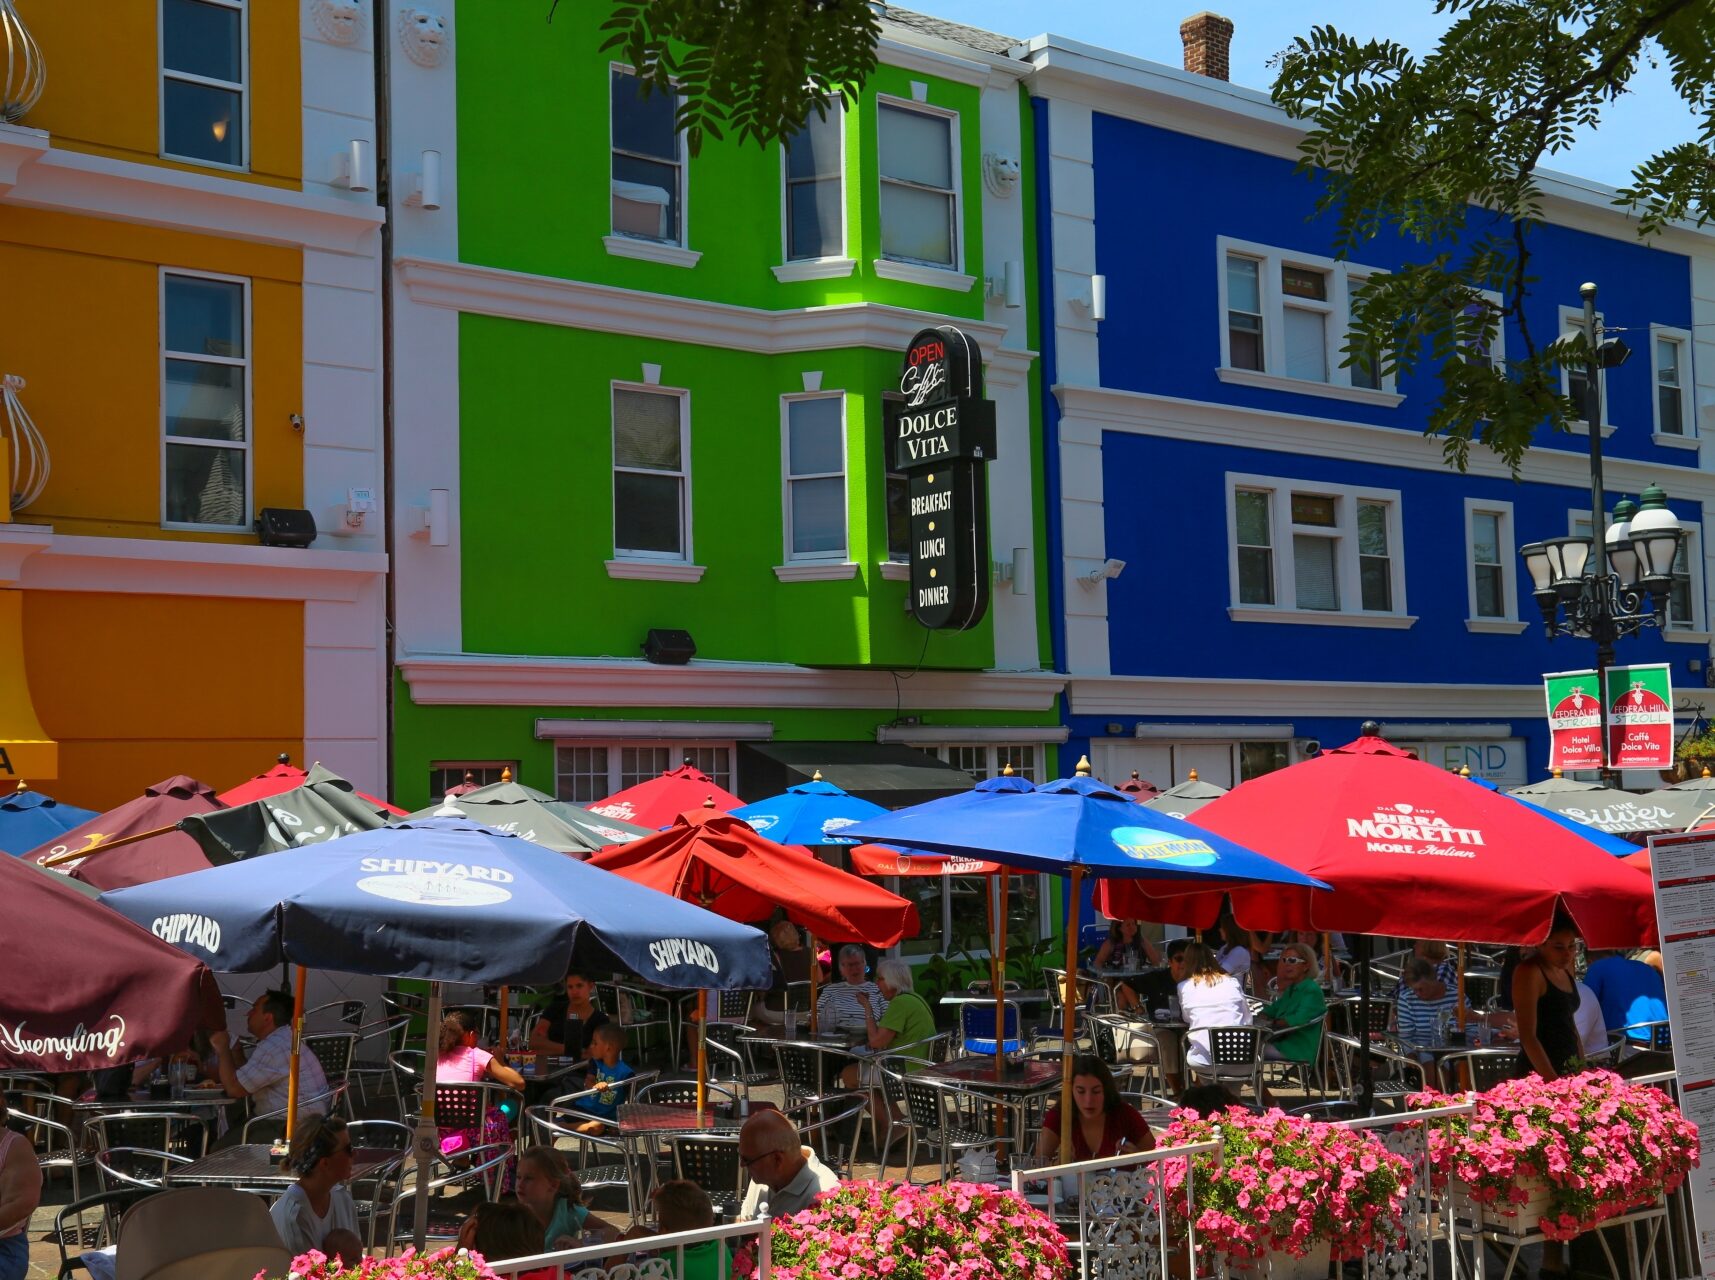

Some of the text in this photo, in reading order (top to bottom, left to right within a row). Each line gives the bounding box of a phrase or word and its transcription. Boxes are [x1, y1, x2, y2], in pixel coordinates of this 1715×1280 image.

[909, 342, 945, 366] OPEN
[899, 406, 957, 438] DOLCE
[907, 434, 950, 460] VITA
[911, 490, 952, 516] BREAKFAST
[919, 537, 946, 559] LUNCH
[919, 586, 949, 607] DINNER
[1555, 708, 1587, 718] FEDERAL
[1614, 703, 1666, 713] FEDERAL HILL
[1615, 713, 1667, 724] STROLL
[1571, 734, 1590, 744] Hotel
[1621, 741, 1660, 751] Dolce Vita
[1628, 732, 1649, 741] Caffé
[1400, 745, 1506, 770] LEND
[1562, 742, 1601, 754] Dolce Villa
[1558, 806, 1676, 825] Silver
[1608, 802, 1637, 811] THE
[1373, 812, 1450, 828] BIRRA
[1346, 818, 1486, 846] MORETTI
[1366, 842, 1476, 859] MORE Italian
[360, 858, 514, 884] SHIPYARD
[152, 913, 221, 954] SHIPYARD
[649, 938, 720, 974] SHIPYARD
